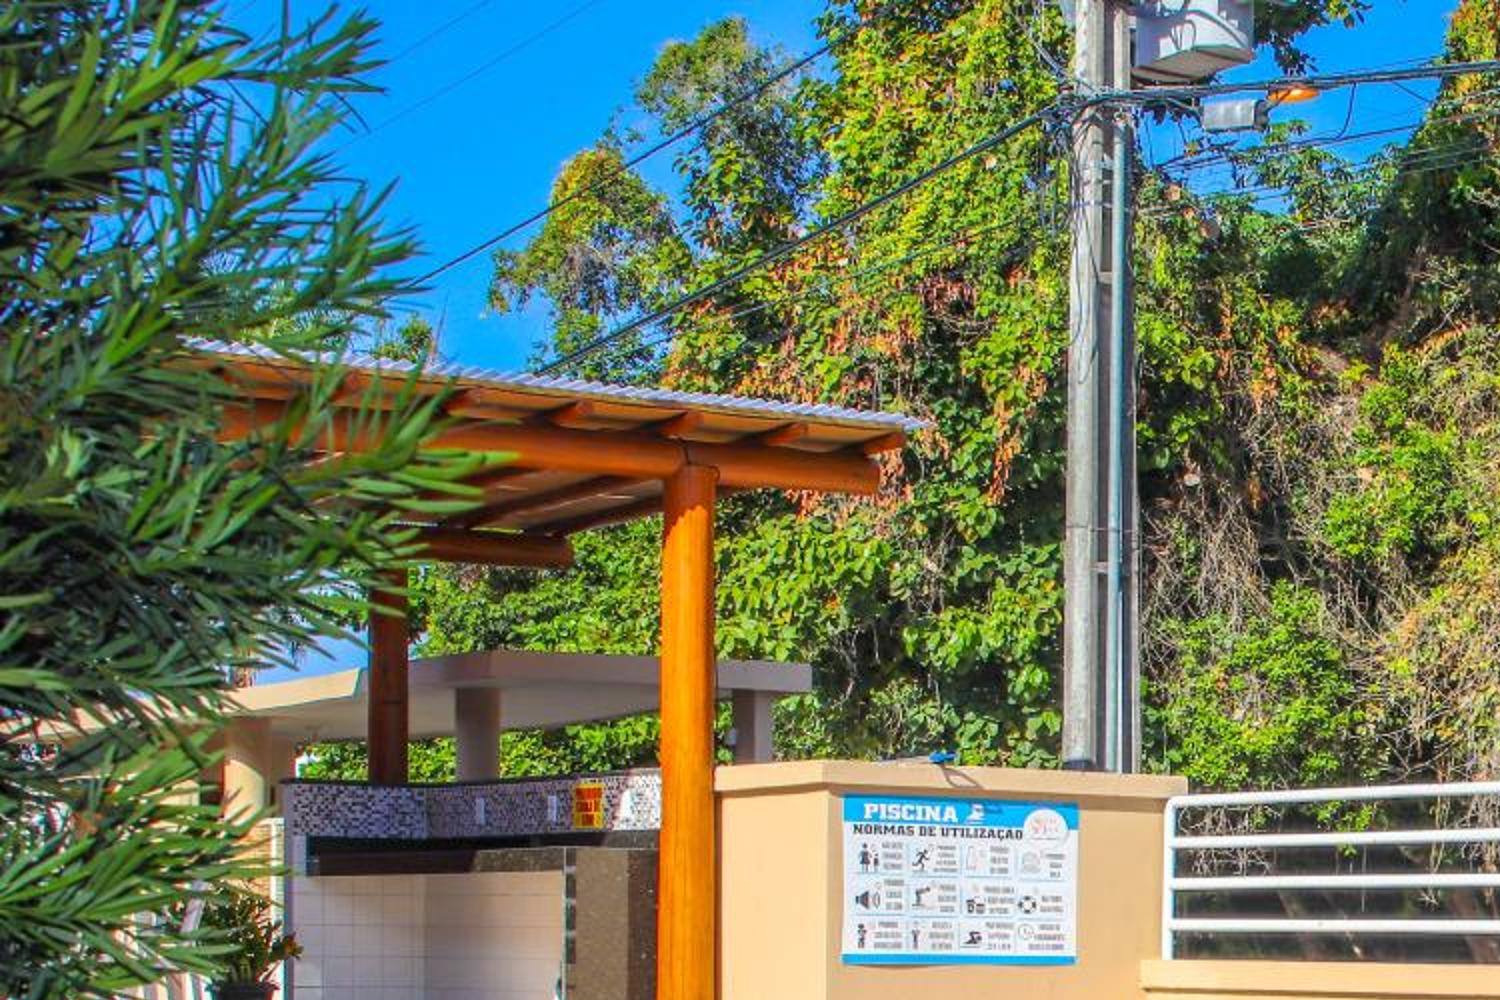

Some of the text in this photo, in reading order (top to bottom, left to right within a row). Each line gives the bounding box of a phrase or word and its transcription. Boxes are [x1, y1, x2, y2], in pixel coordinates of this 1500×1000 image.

[863, 803, 959, 822] PISCINA
[853, 824, 915, 837] NORMAS
[918, 826, 936, 837] DE
